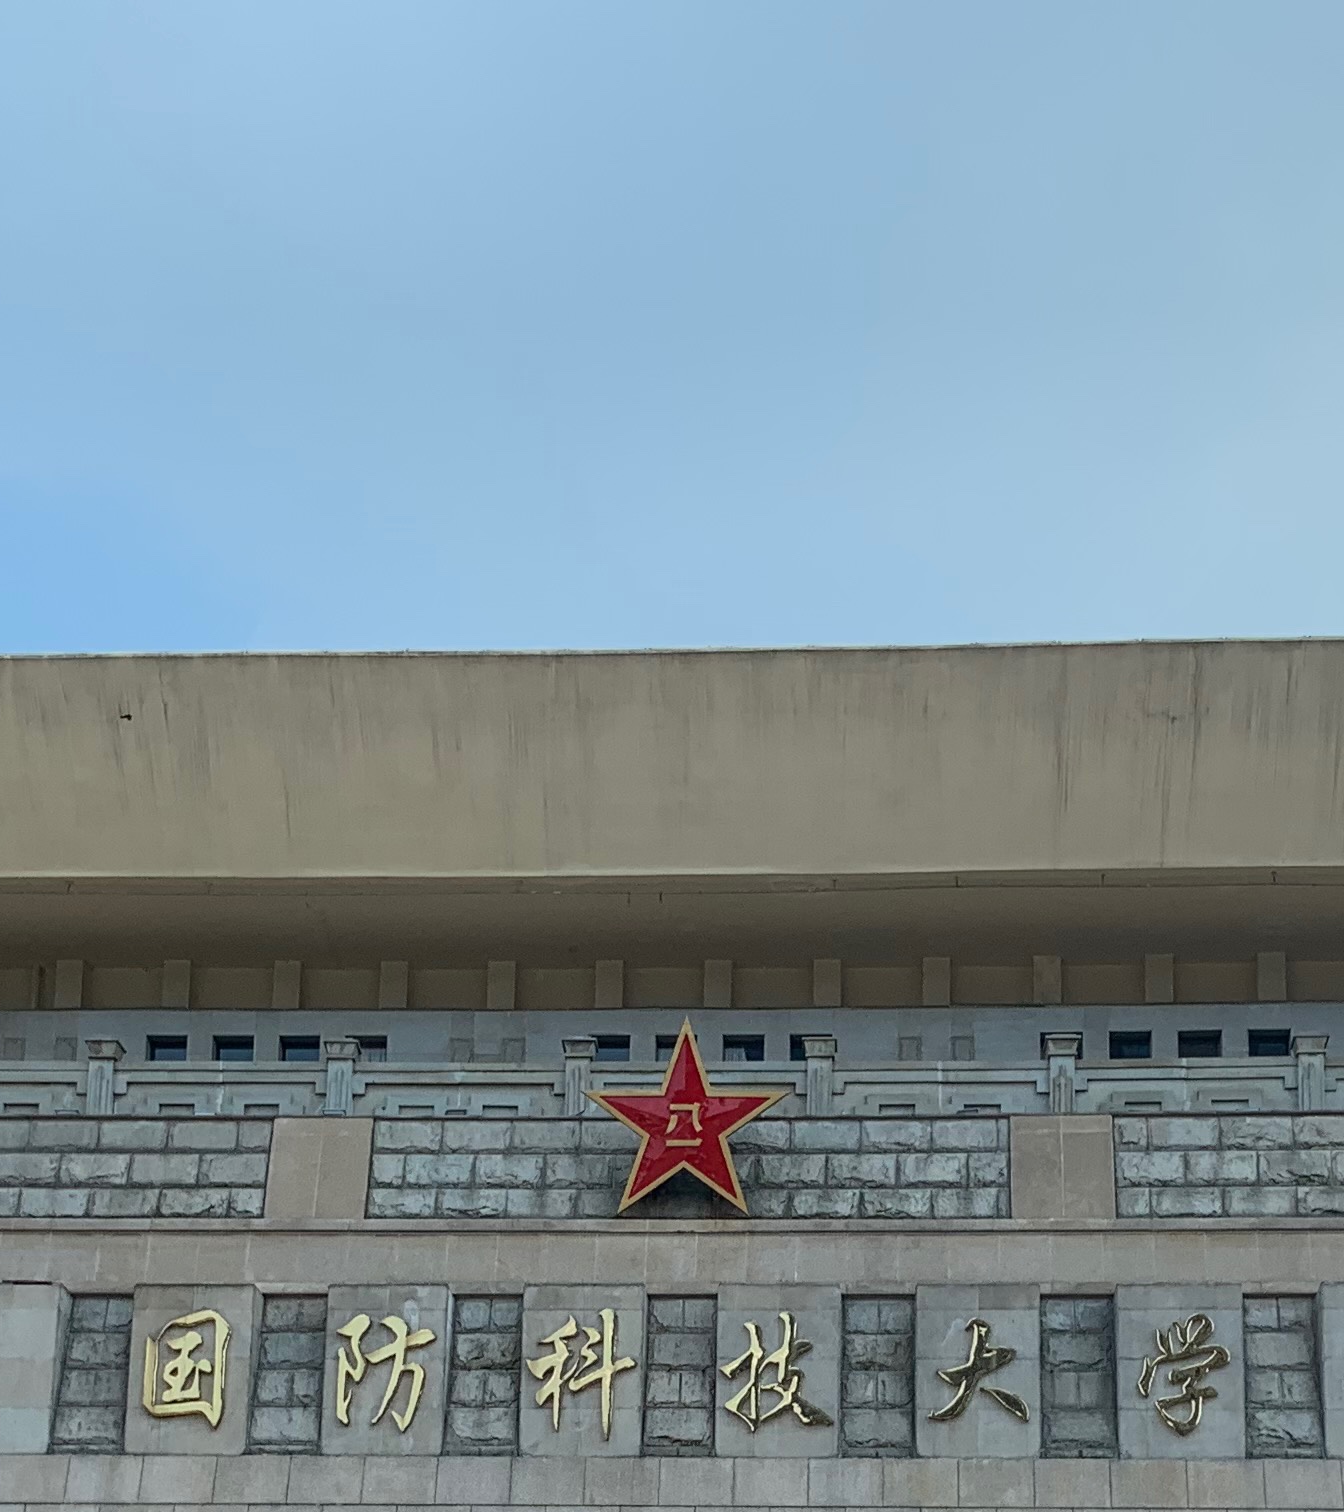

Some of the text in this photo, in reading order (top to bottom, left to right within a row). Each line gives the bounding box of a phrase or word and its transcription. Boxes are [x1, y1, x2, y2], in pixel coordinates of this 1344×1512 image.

[143, 1308, 1230, 1441] 国防科技大学
